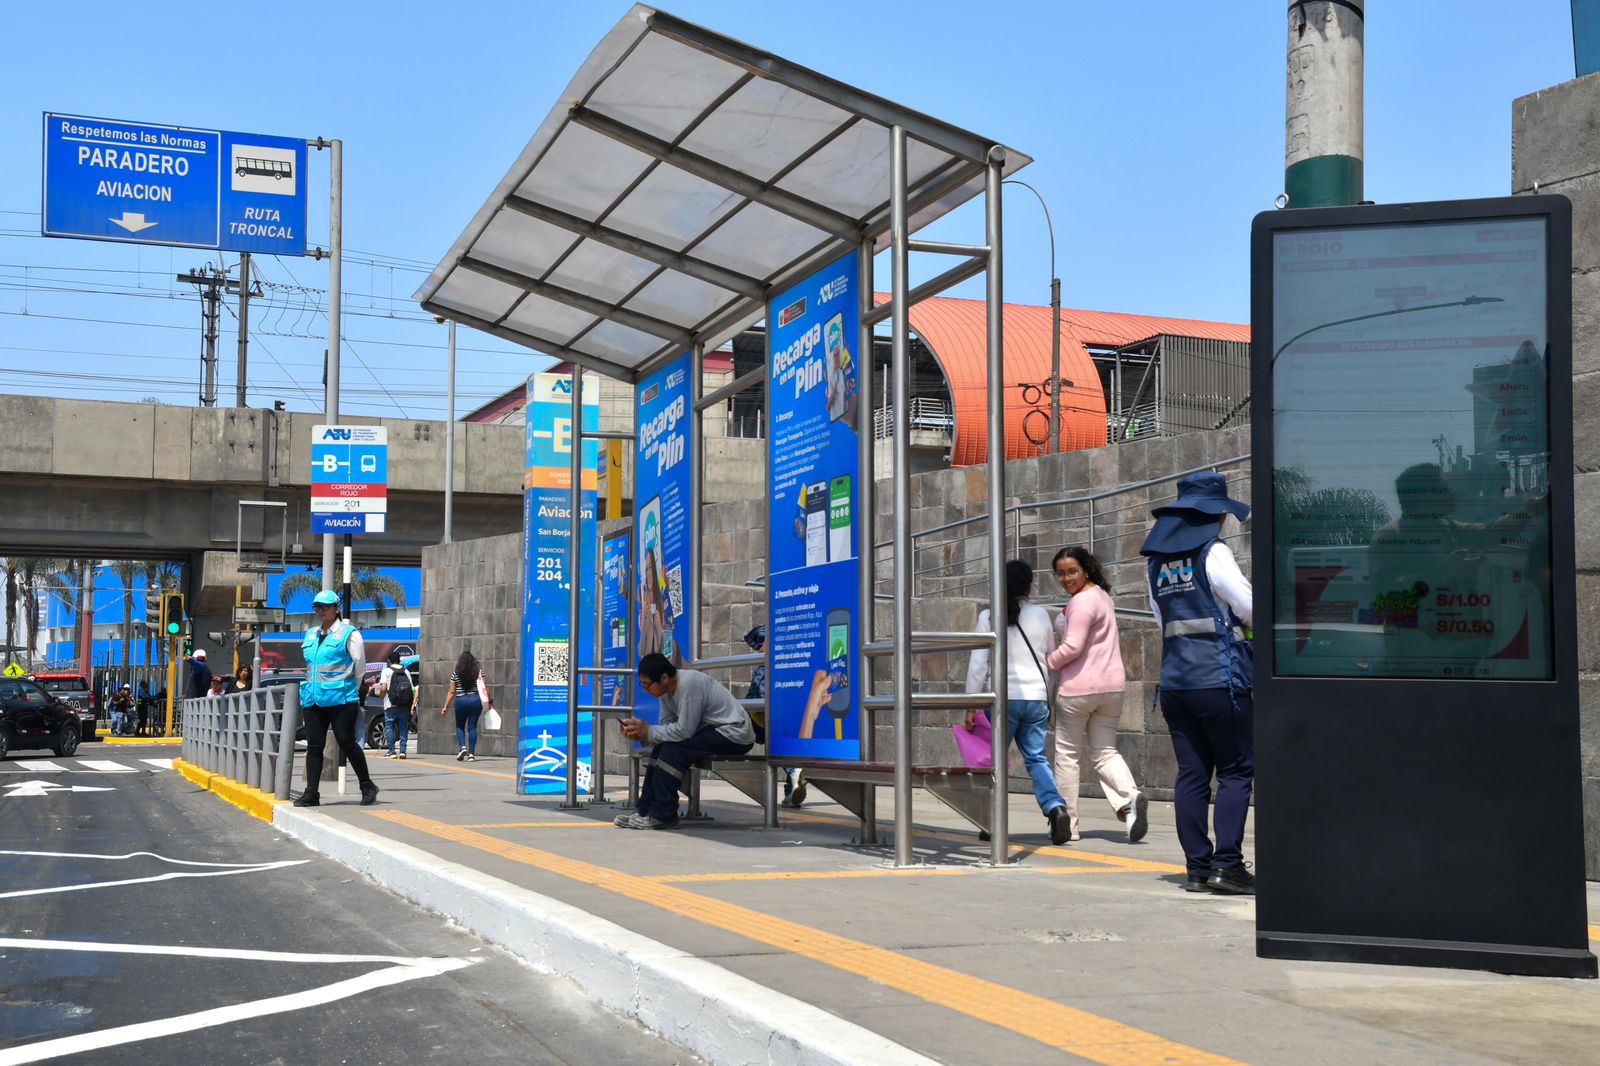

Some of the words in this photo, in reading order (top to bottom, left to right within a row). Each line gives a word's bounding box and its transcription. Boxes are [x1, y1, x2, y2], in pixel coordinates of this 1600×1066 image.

[62, 122, 138, 141] Respetemos
[141, 130, 158, 144] las
[161, 134, 207, 150] Normas
[78, 146, 190, 176] PARADERO
[96, 180, 173, 202] AVIACION
[244, 206, 281, 222] RUTA
[230, 222, 294, 240] TRONCAL
[773, 322, 821, 380] Recarga
[780, 372, 787, 386] en
[787, 366, 796, 380] un
[795, 356, 822, 400] Plin
[1500, 382, 1529, 391] Ahora
[640, 394, 685, 452] Recarga
[322, 428, 351, 440] ATU
[645, 446, 651, 460] en
[650, 440, 659, 455] un
[658, 432, 684, 478] Plin
[324, 455, 338, 472] B
[324, 517, 362, 527] AVIACIÓN
[552, 528, 571, 537] Borja
[537, 558, 562, 568] 201
[1156, 557, 1193, 587] ATU
[537, 570, 563, 582] 204
[1436, 593, 1491, 607] S/1.00
[1436, 620, 1494, 634] S/0.50
